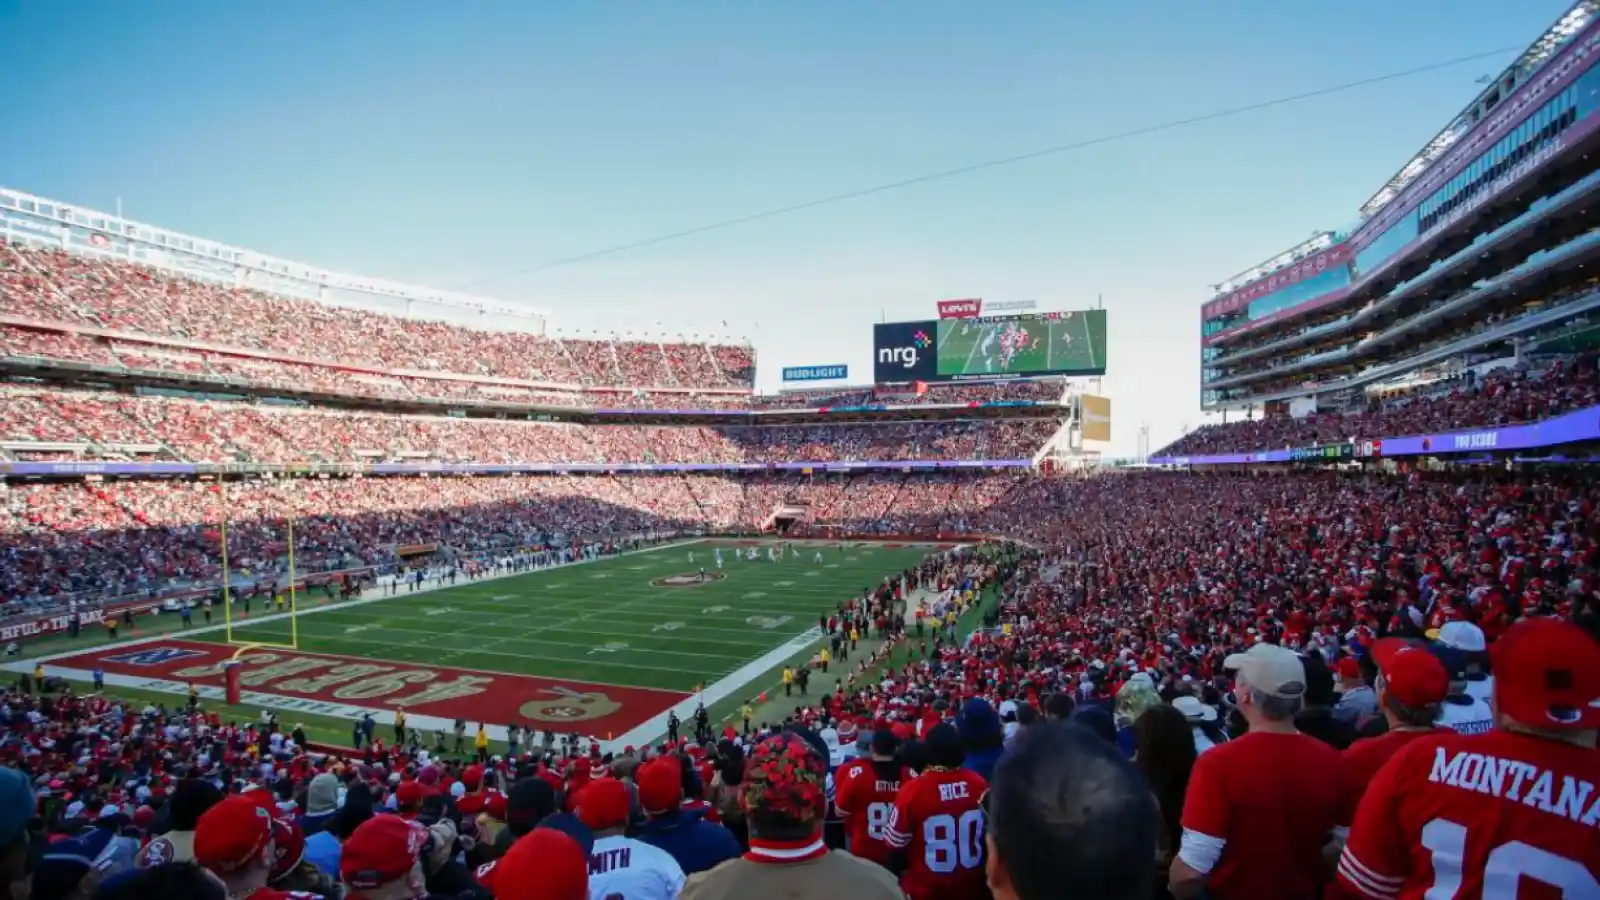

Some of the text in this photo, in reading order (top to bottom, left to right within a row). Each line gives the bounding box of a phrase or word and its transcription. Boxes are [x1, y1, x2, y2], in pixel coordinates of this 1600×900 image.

[879, 346, 916, 368] nrg
[938, 781, 969, 802] RICE
[923, 809, 984, 873] 80
